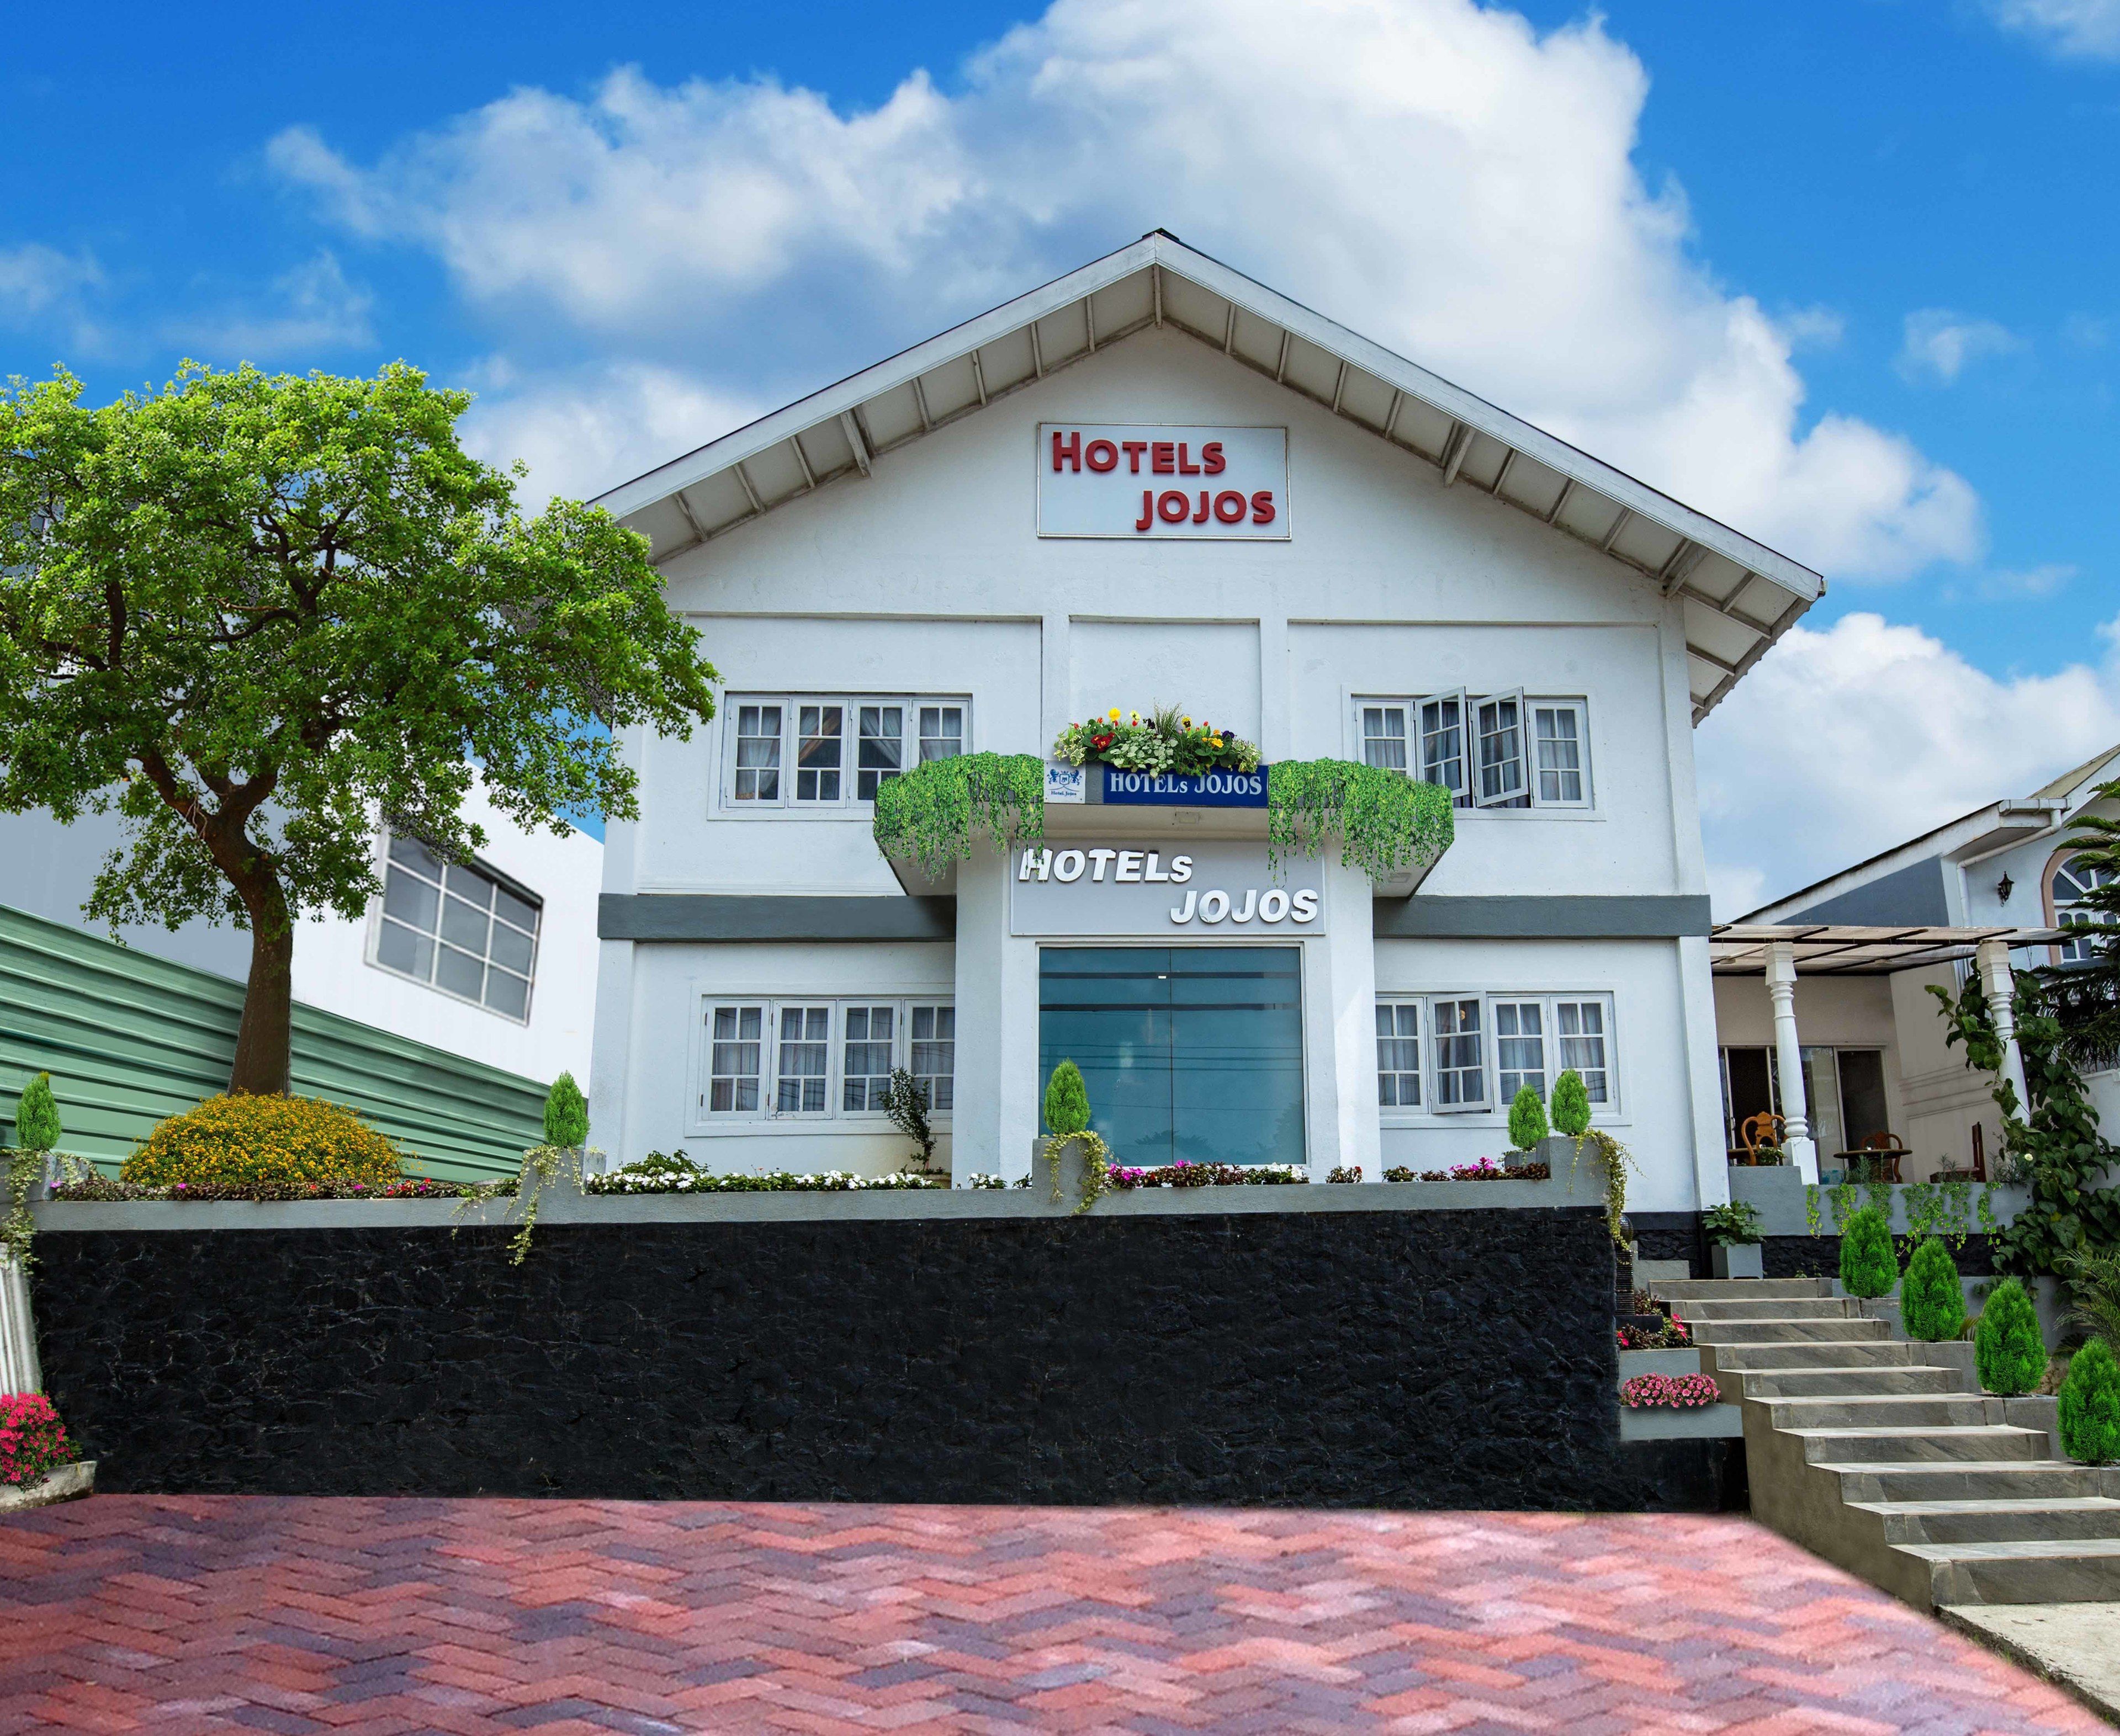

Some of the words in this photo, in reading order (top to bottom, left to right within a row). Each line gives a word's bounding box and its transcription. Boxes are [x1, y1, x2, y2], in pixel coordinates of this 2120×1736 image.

[1052, 431, 1227, 474] HOTELS
[1136, 490, 1276, 530] JOJOS
[1194, 774, 1262, 795] JOJOS
[1170, 888, 1318, 924] JOJOS
